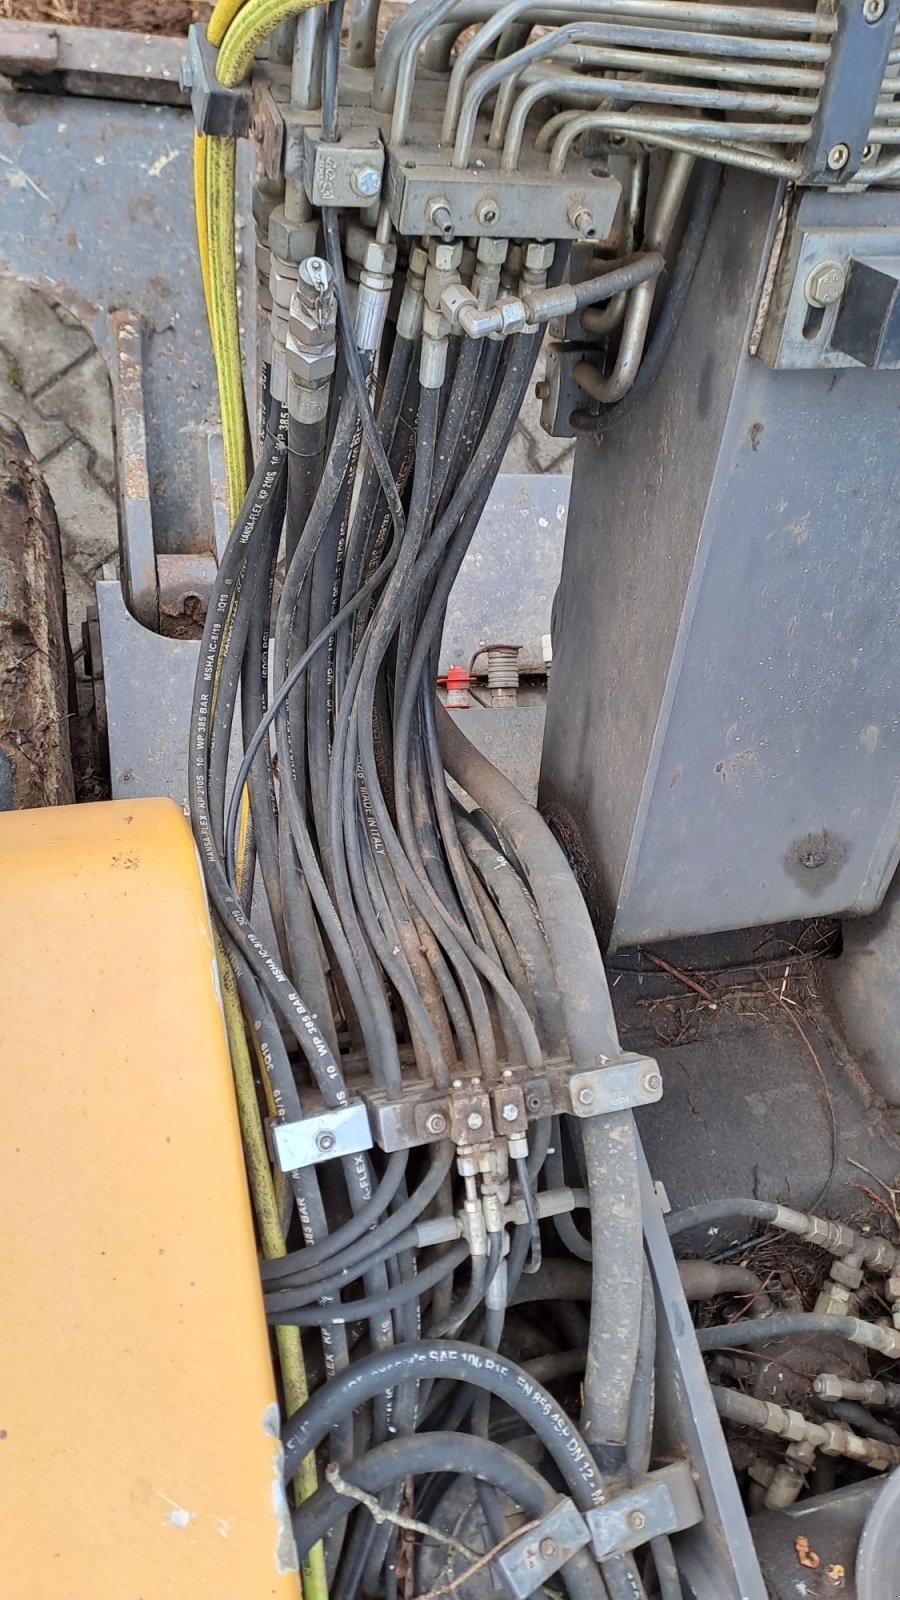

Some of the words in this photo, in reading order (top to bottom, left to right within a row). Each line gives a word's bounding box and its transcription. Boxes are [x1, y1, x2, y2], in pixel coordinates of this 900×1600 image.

[239, 503, 263, 544] HANSA-FLEX
[257, 488, 269, 500] KP
[266, 471, 278, 489] 210S
[278, 412, 289, 434] 385
[217, 594, 228, 613] 3Q19
[208, 623, 221, 652] IC-8/19
[203, 655, 215, 681] MSHA
[199, 694, 210, 714] BAR
[198, 714, 208, 734] 385
[196, 734, 205, 750] WP
[196, 757, 204, 767] 10
[196, 775, 205, 795] 210S
[197, 796, 207, 809] KP
[360, 786, 373, 816] MADE
[367, 817, 377, 827] IN
[200, 815, 217, 862] HANSA-FLEX
[370, 829, 386, 856] ITALY
[231, 909, 248, 926] 3Q19
[265, 958, 287, 982] MSHA
[288, 992, 306, 1014] BAR
[301, 1015, 317, 1035] 385
[260, 1042, 274, 1072] 3Q19
[313, 1036, 328, 1057] WP
[326, 1065, 339, 1080] 10
[296, 1197, 310, 1224] BAR
[566, 1437, 585, 1463] DN
[579, 1461, 594, 1481] 12
